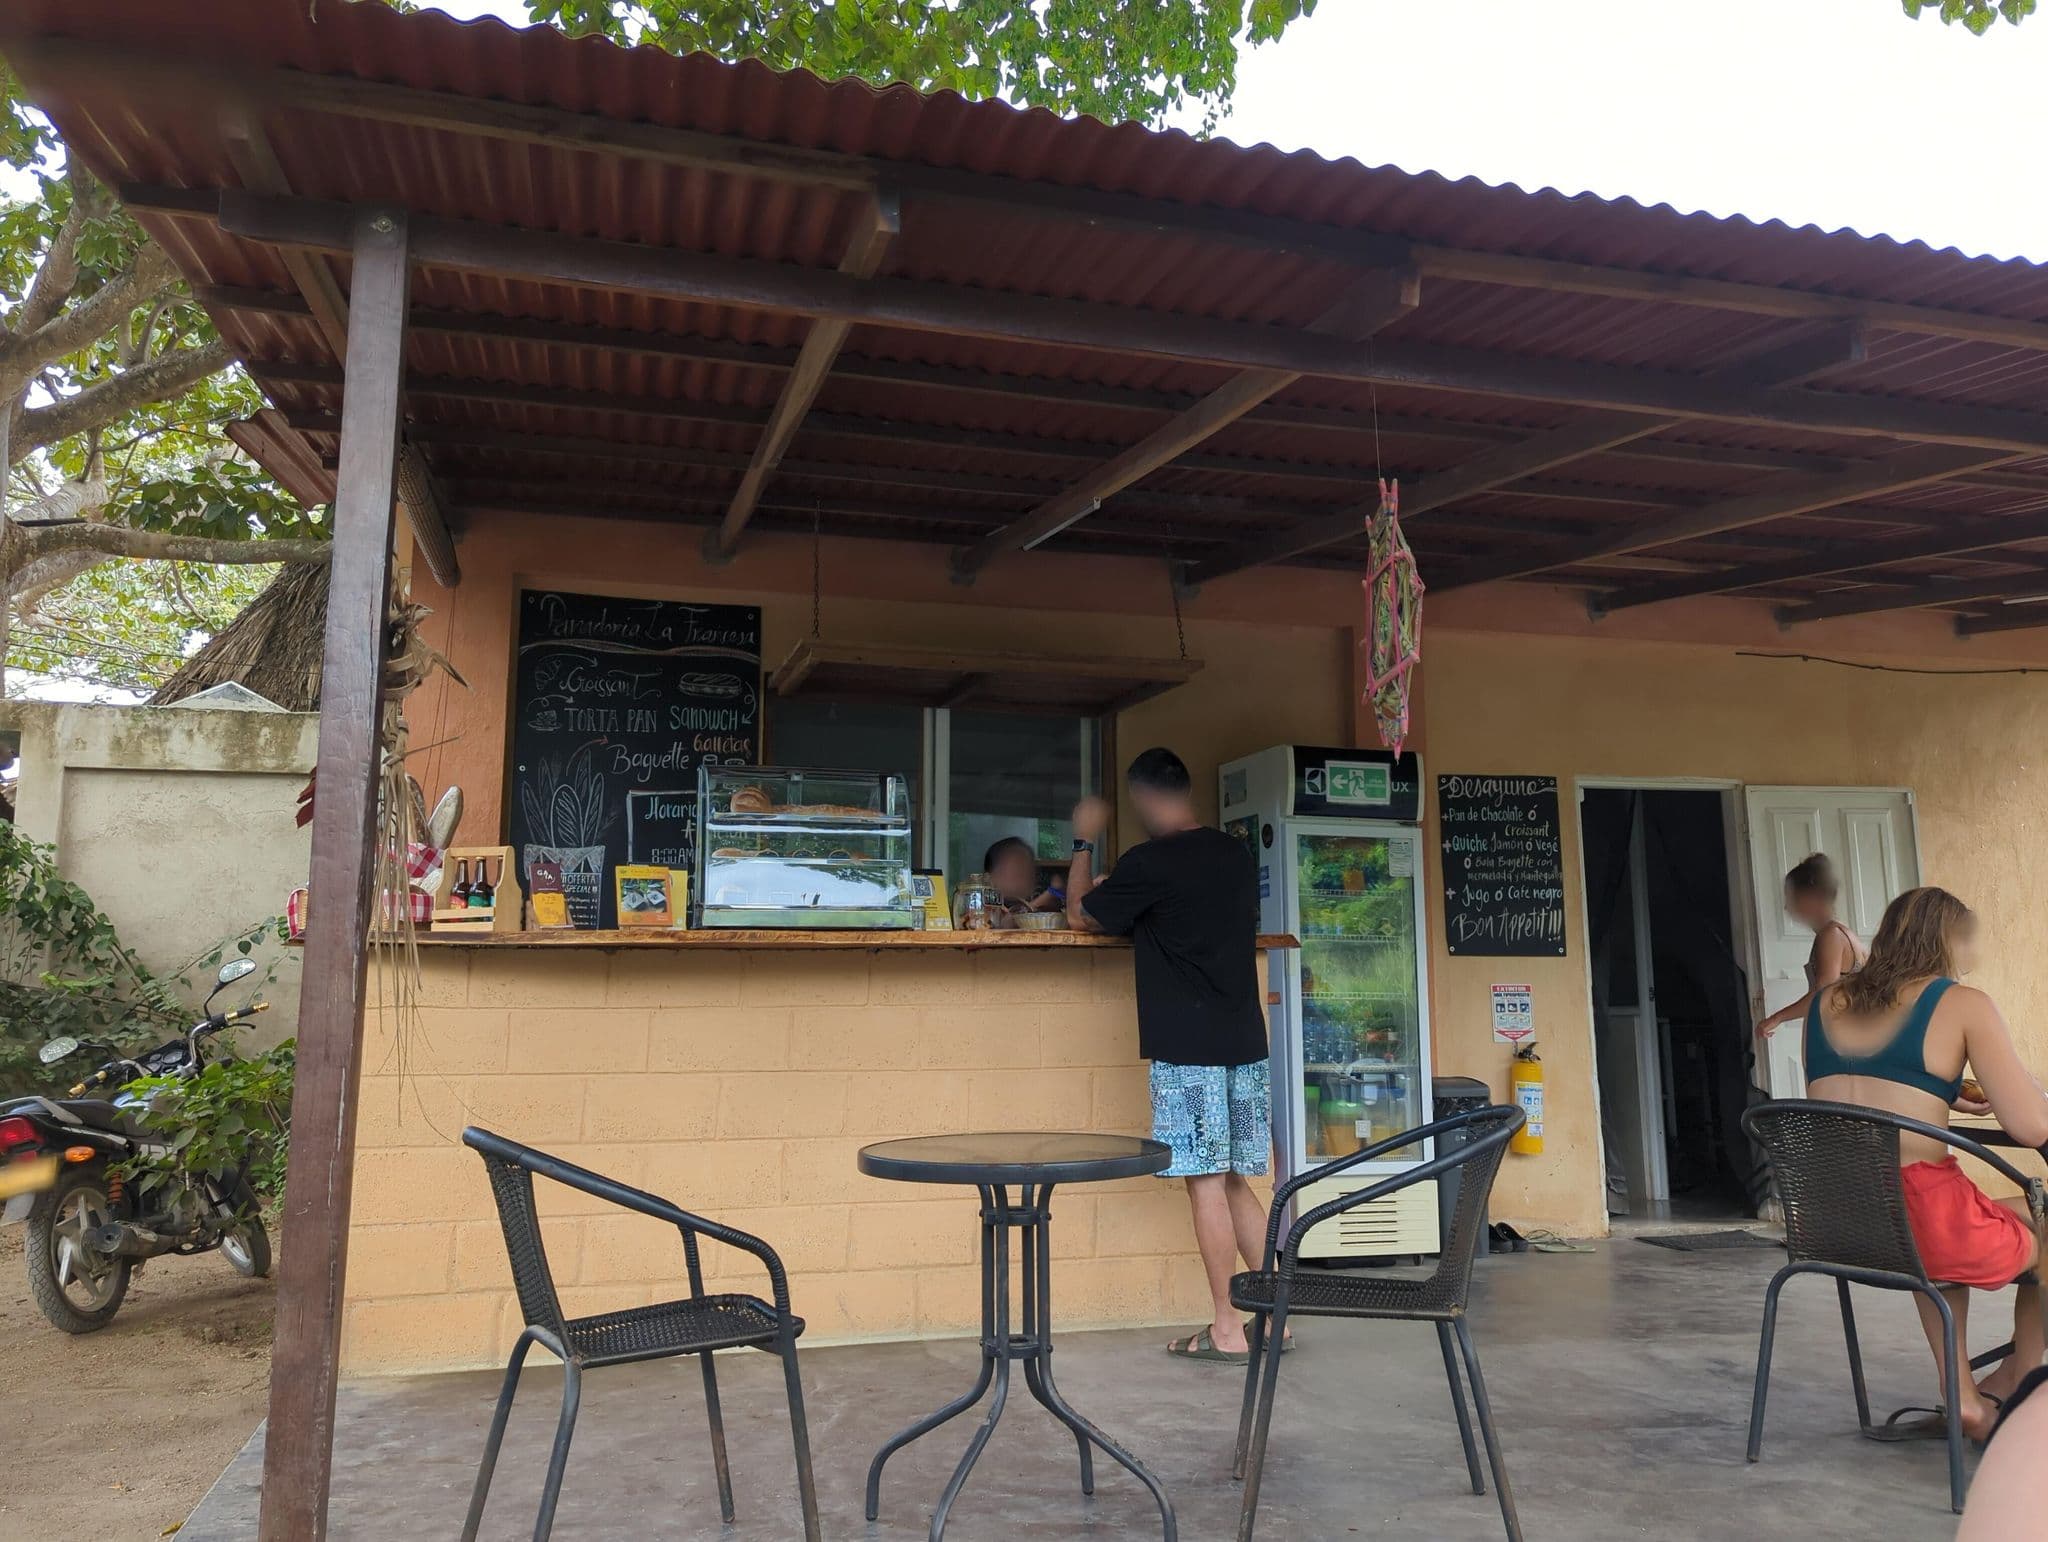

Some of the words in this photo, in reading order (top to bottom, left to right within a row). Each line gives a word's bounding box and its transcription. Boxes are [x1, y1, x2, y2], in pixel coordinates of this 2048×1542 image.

[563, 707, 619, 732] TORTA
[626, 707, 657, 732] PAN
[606, 741, 690, 783] Baguette
[1446, 775, 1539, 807] Desayuno
[1449, 807, 1466, 822] Pan
[1467, 806, 1479, 822] de
[1481, 805, 1524, 823] Chocolate
[1505, 821, 1550, 837] Croissant
[1452, 833, 1488, 853] Quiche
[1536, 858, 1553, 867] con
[1461, 883, 1490, 912] Jugo
[1533, 887, 1563, 910] negro
[1450, 912, 1494, 943] Bon
